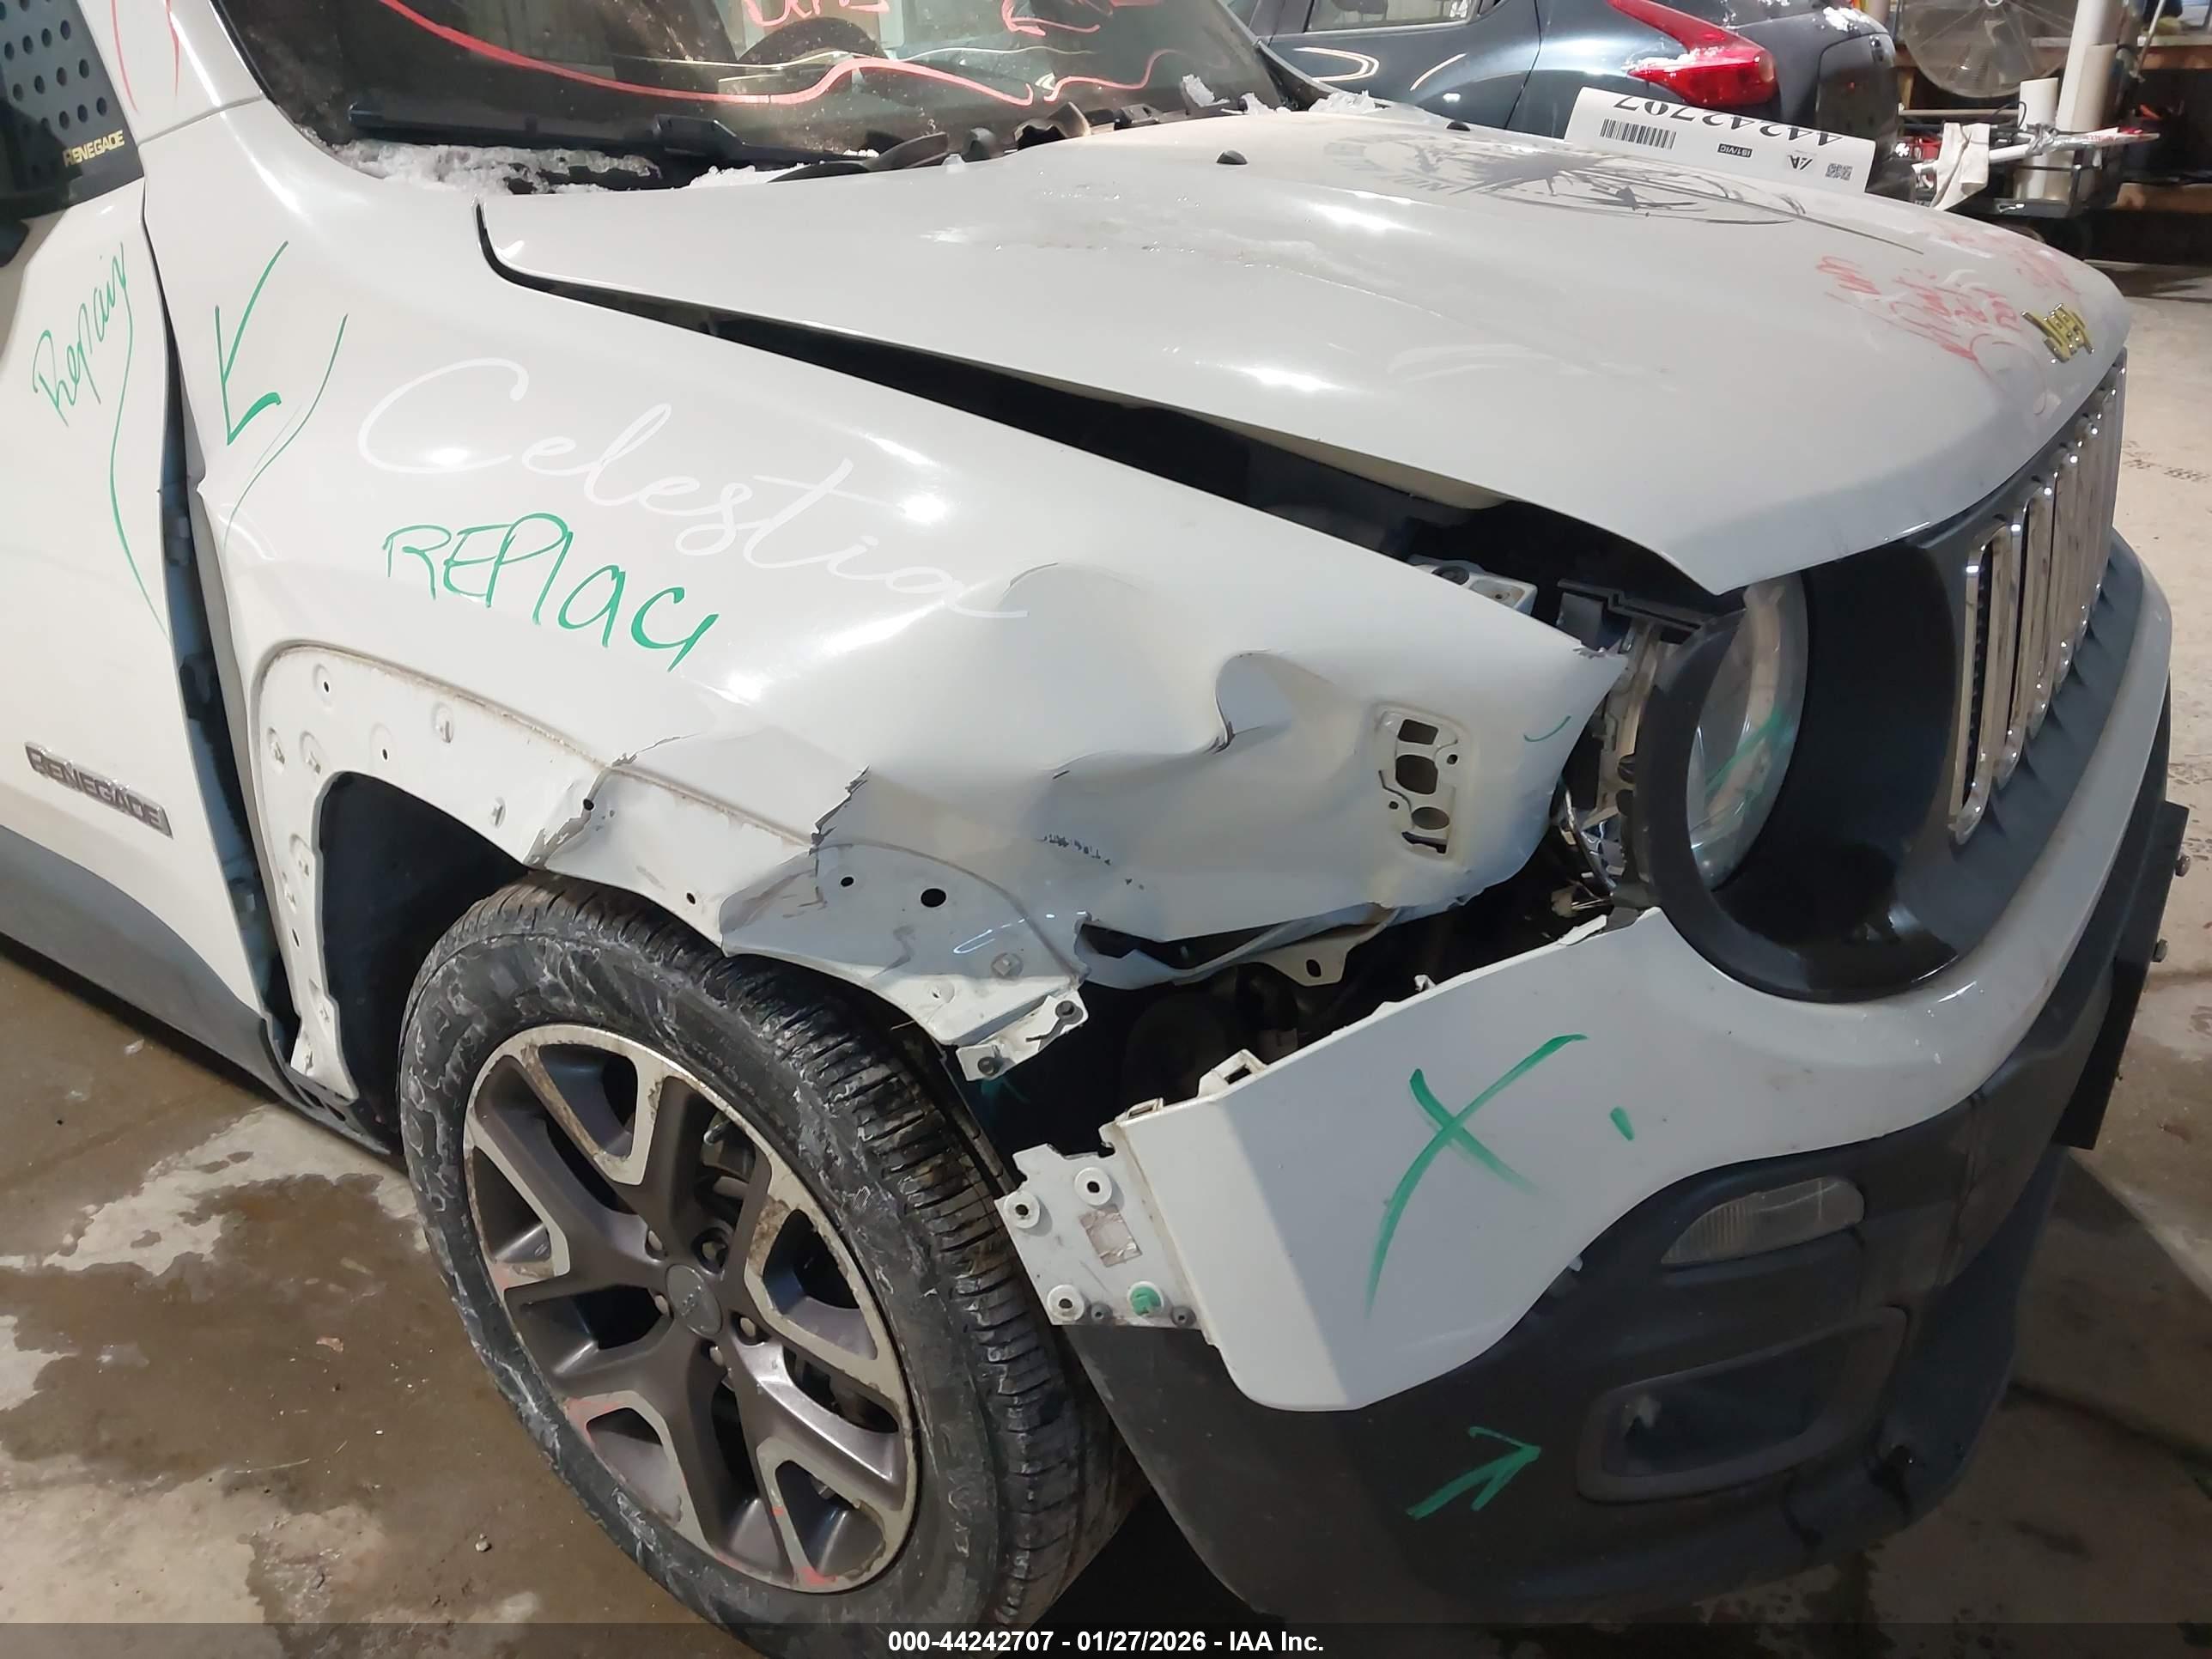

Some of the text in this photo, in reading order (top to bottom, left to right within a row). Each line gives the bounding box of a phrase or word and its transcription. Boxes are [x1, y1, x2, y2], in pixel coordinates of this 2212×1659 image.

[63, 130, 125, 167] RENEGADE
[357, 357, 1030, 619] Celestia
[26, 743, 171, 837] RENEGADE
